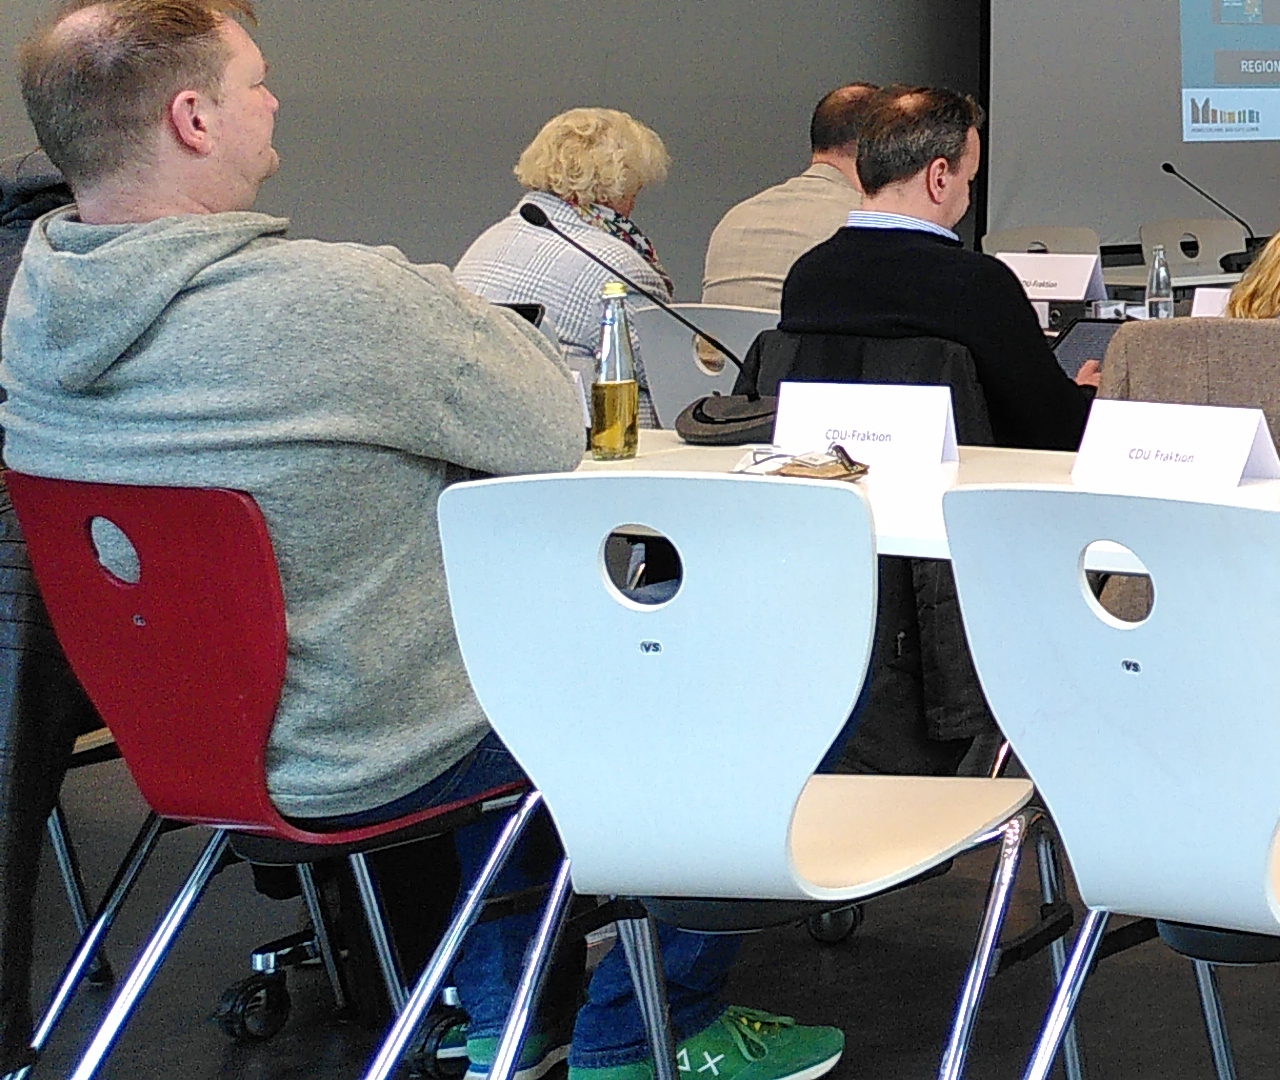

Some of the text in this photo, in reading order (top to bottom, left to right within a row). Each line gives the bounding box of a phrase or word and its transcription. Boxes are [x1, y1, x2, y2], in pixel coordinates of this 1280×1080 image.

[825, 428, 892, 442] CDU-Fraktion
[643, 642, 660, 653] VS
[1124, 660, 1140, 672] VS
